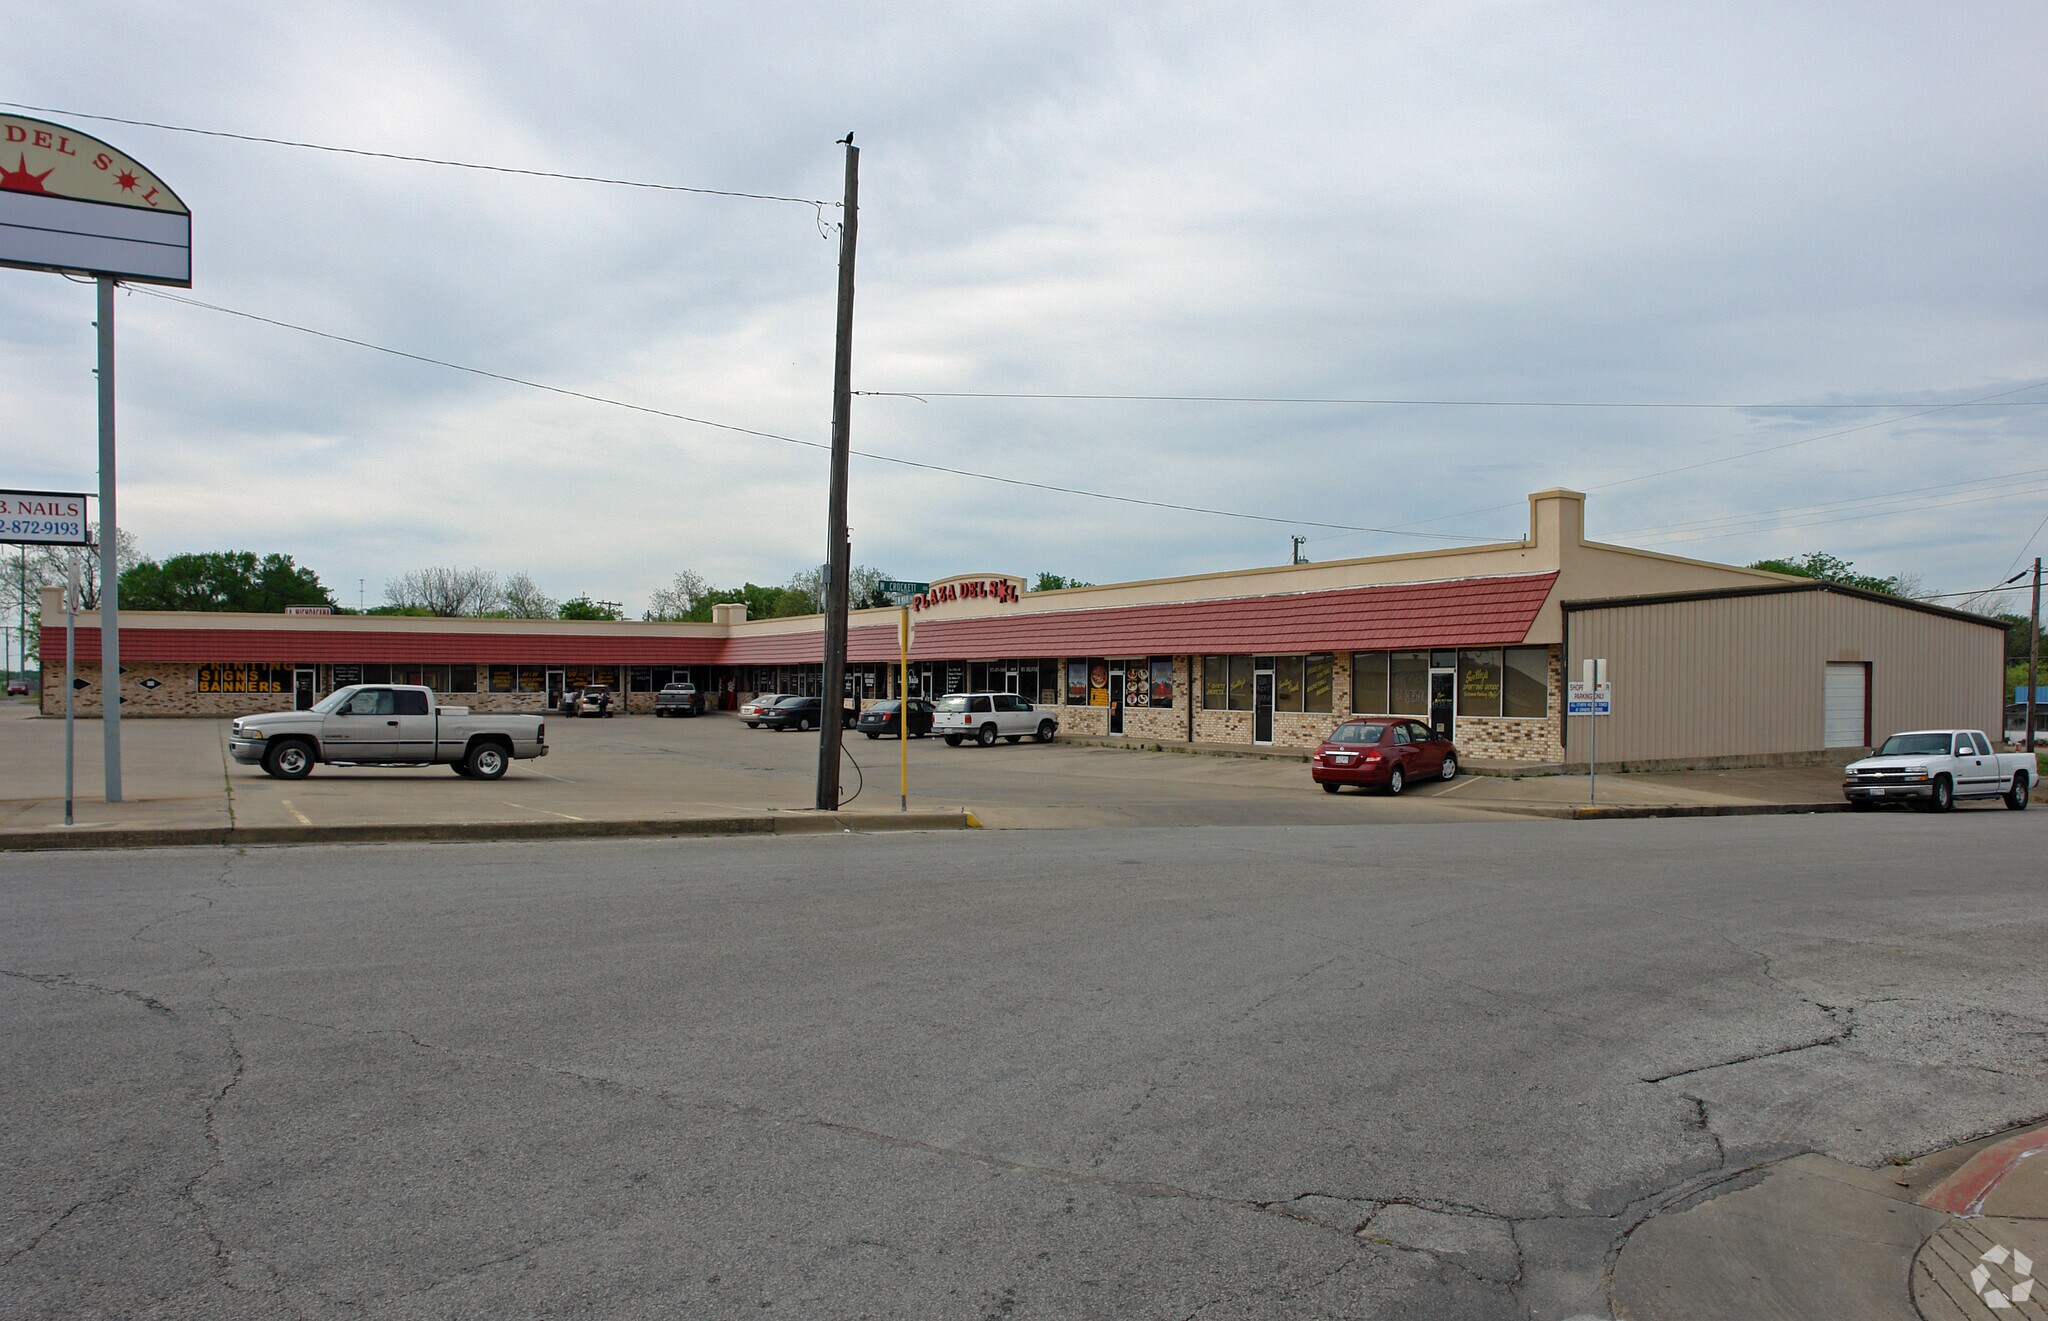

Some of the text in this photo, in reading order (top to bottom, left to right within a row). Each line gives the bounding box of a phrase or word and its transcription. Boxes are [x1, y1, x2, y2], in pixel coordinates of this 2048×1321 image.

[5, 124, 76, 156] DEL
[18, 501, 79, 516] NAILS
[0, 519, 79, 535] 2-872-9193
[889, 582, 917, 592] CROCKETT
[912, 584, 957, 612] PLAZA
[959, 581, 987, 599] DEL
[198, 662, 293, 671] PRINTING
[201, 670, 259, 681] SIGNS
[199, 681, 281, 692] BANNERS
